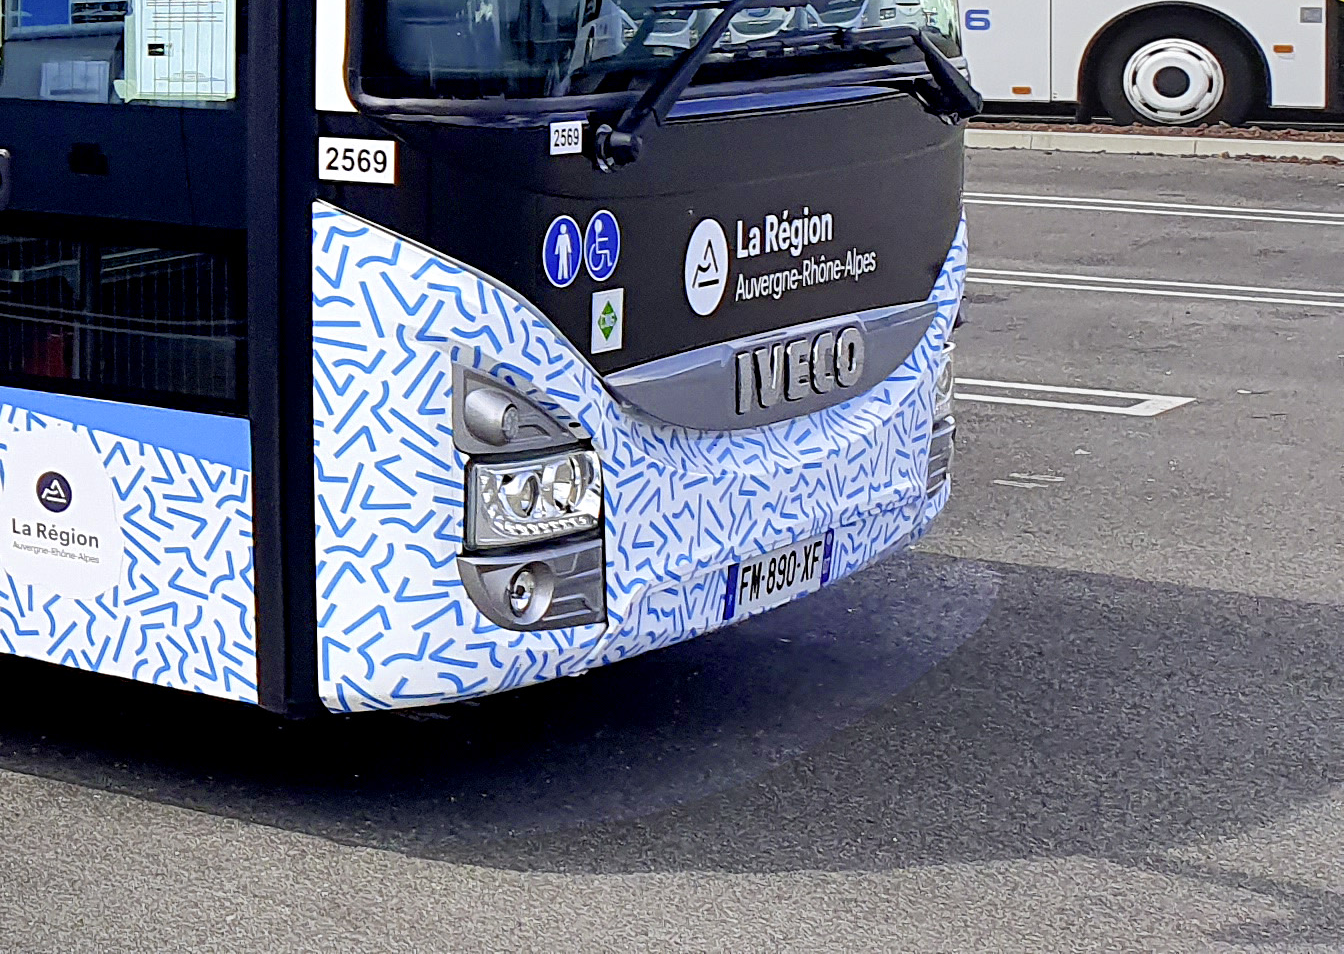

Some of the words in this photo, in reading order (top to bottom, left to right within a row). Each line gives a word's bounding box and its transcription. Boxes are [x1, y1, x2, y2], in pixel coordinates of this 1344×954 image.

[553, 127, 580, 147] 2569
[325, 146, 388, 173] 2569
[736, 220, 760, 258] La
[765, 206, 833, 257] Région
[735, 247, 877, 302] Auvergne-Rhône-Alpes
[736, 326, 865, 415] IVECO
[12, 517, 31, 536] La
[36, 522, 99, 549] Région
